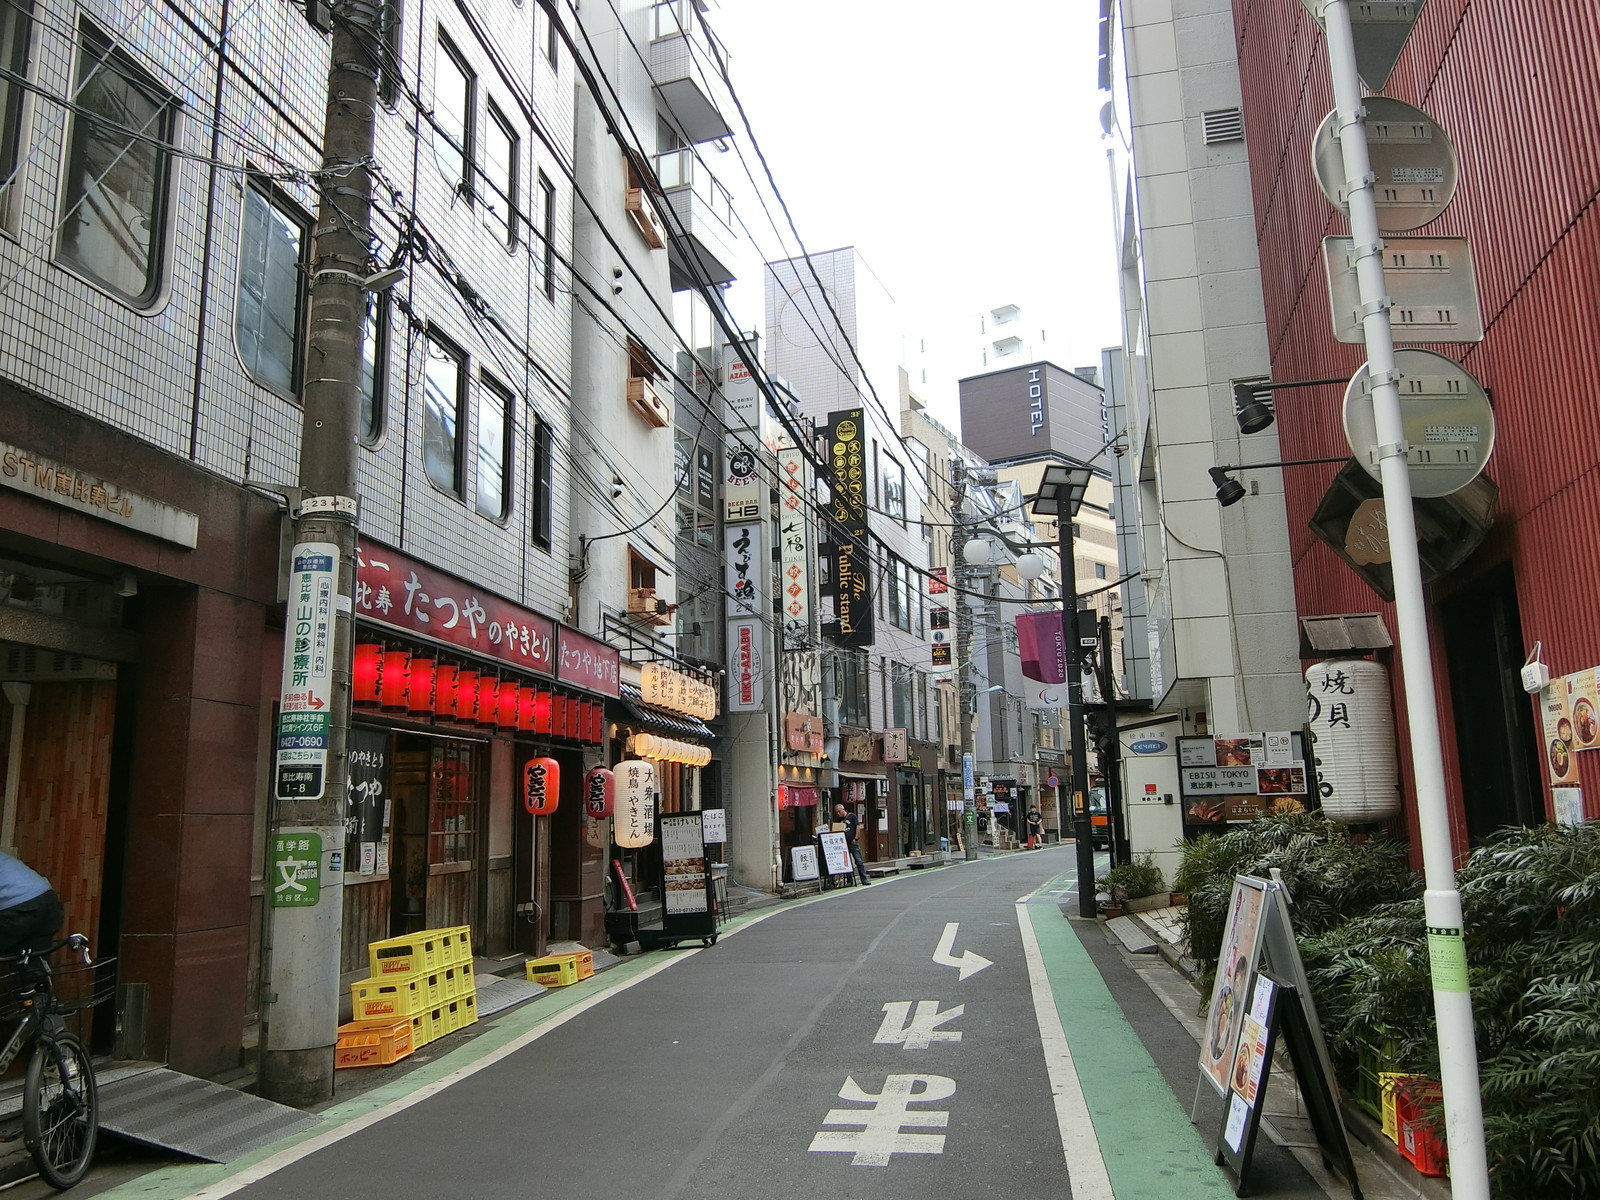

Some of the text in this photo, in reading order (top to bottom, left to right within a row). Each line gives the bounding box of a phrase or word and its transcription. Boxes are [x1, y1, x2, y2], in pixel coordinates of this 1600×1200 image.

[1028, 368, 1043, 436] HOTEL
[2, 452, 134, 518] STM恵比寿ビル
[727, 472, 758, 486] BEER
[312, 499, 327, 507] 23
[728, 505, 759, 518] HB
[838, 544, 856, 635] Public stand
[853, 571, 867, 601] The
[314, 581, 329, 674] 心療内科・精神科・内科
[404, 571, 550, 662] たつやのやきとり
[560, 640, 616, 684] たつや地下店
[1054, 631, 1065, 678] TOKYO 2020
[1321, 669, 1355, 728] 焼貝
[281, 737, 323, 747] 6427-0690
[282, 773, 313, 782] 恵比寿南
[527, 764, 546, 809] やきとり
[588, 773, 606, 812] やきとり
[1189, 771, 1249, 780] EBISU TOKYO
[1190, 781, 1252, 790] 恵比寿トーキョー
[628, 767, 640, 840] 焼鳥・やきとん
[704, 812, 724, 820] たばこ
[677, 817, 701, 827] けいじ
[340, 1049, 378, 1063] ホッピー
